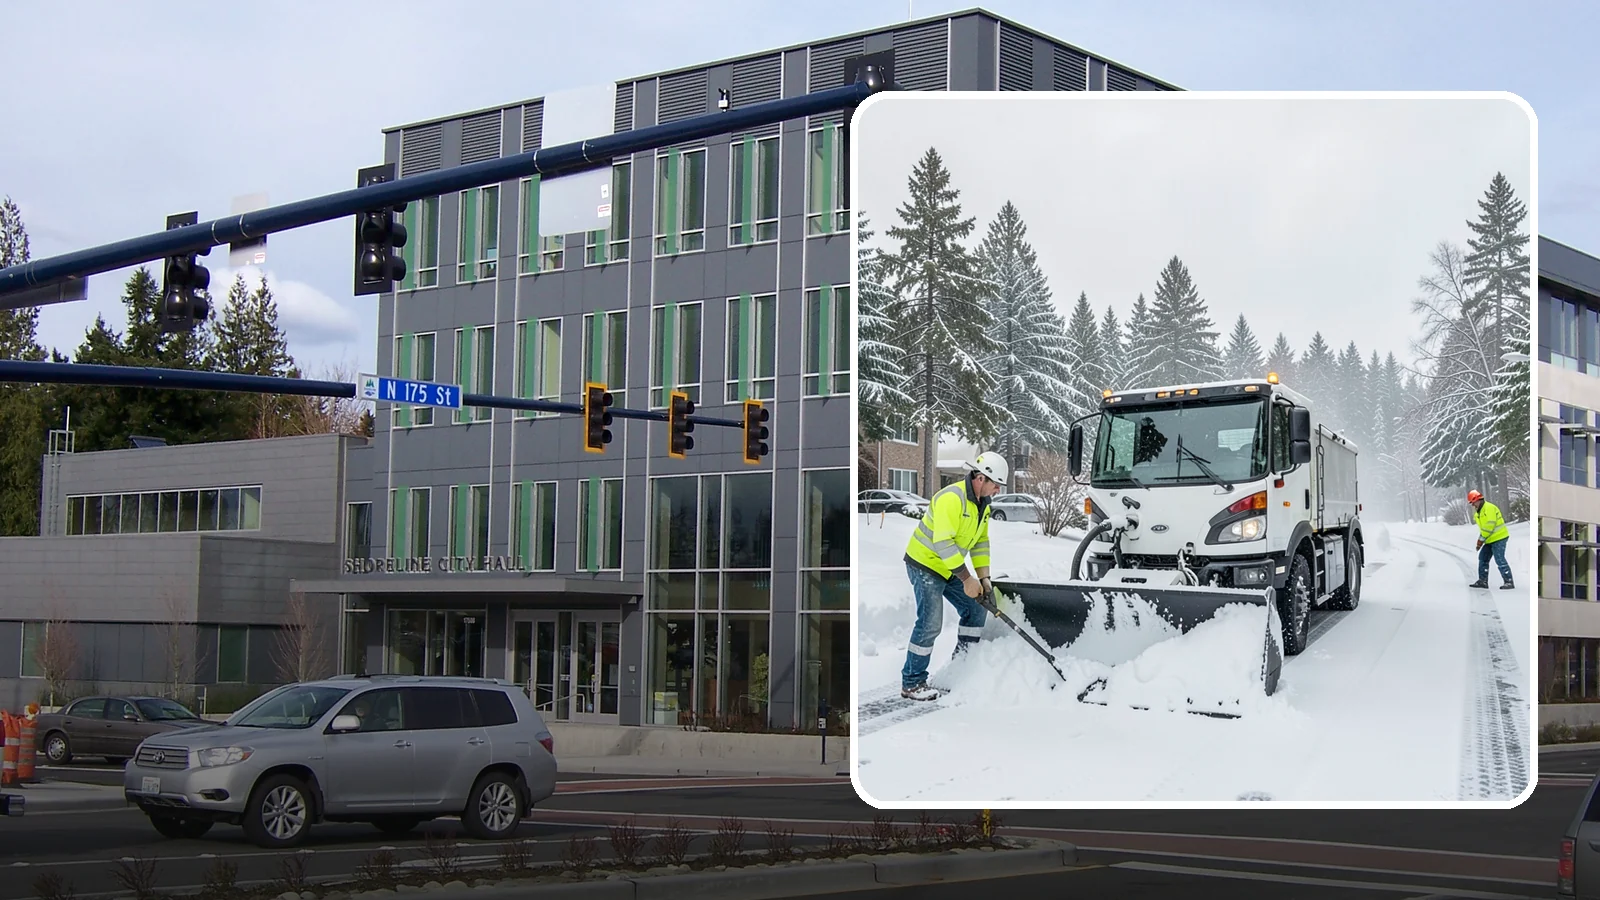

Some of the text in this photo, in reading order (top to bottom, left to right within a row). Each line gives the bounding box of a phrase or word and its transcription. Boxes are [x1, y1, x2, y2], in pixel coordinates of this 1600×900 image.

[387, 380, 452, 406] N 175 St
[343, 556, 525, 574] SHORELINE CITY HALL
